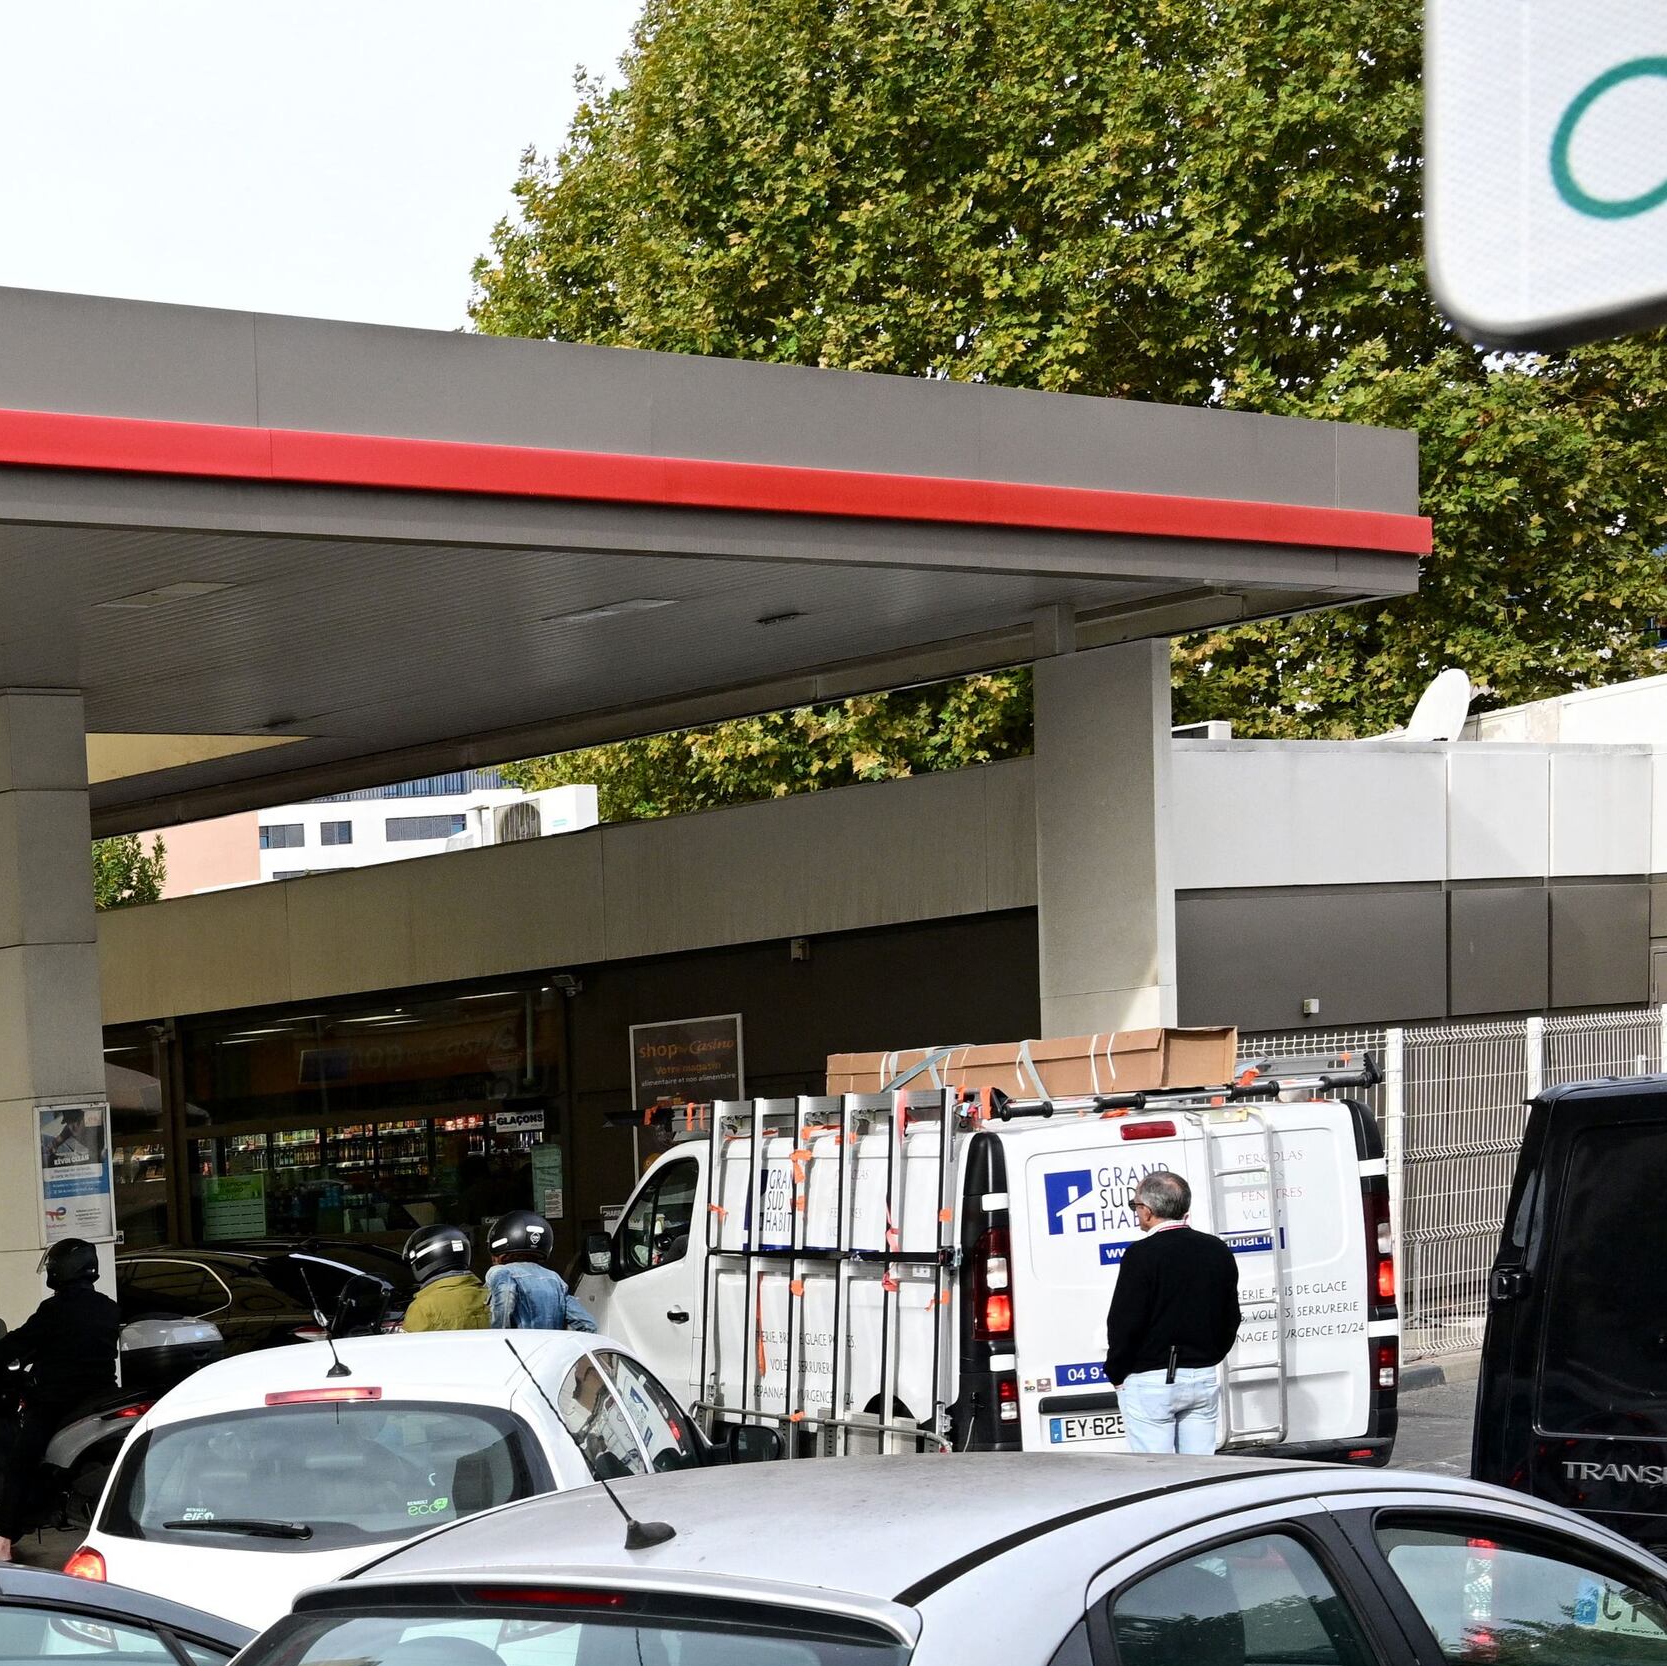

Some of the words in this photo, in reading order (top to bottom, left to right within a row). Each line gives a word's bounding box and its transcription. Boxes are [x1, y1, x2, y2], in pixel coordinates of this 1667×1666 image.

[639, 1042, 678, 1060] shop
[689, 1038, 735, 1056] Casino
[496, 1113, 544, 1127] GLAÇONS
[766, 1191, 784, 1211] SUD
[1296, 1284, 1309, 1295] DE
[1312, 1280, 1348, 1293] GLACE
[1297, 1301, 1360, 1317] SERRURERIE
[1336, 1322, 1366, 1335] 12/24
[1068, 1367, 1087, 1381] 04
